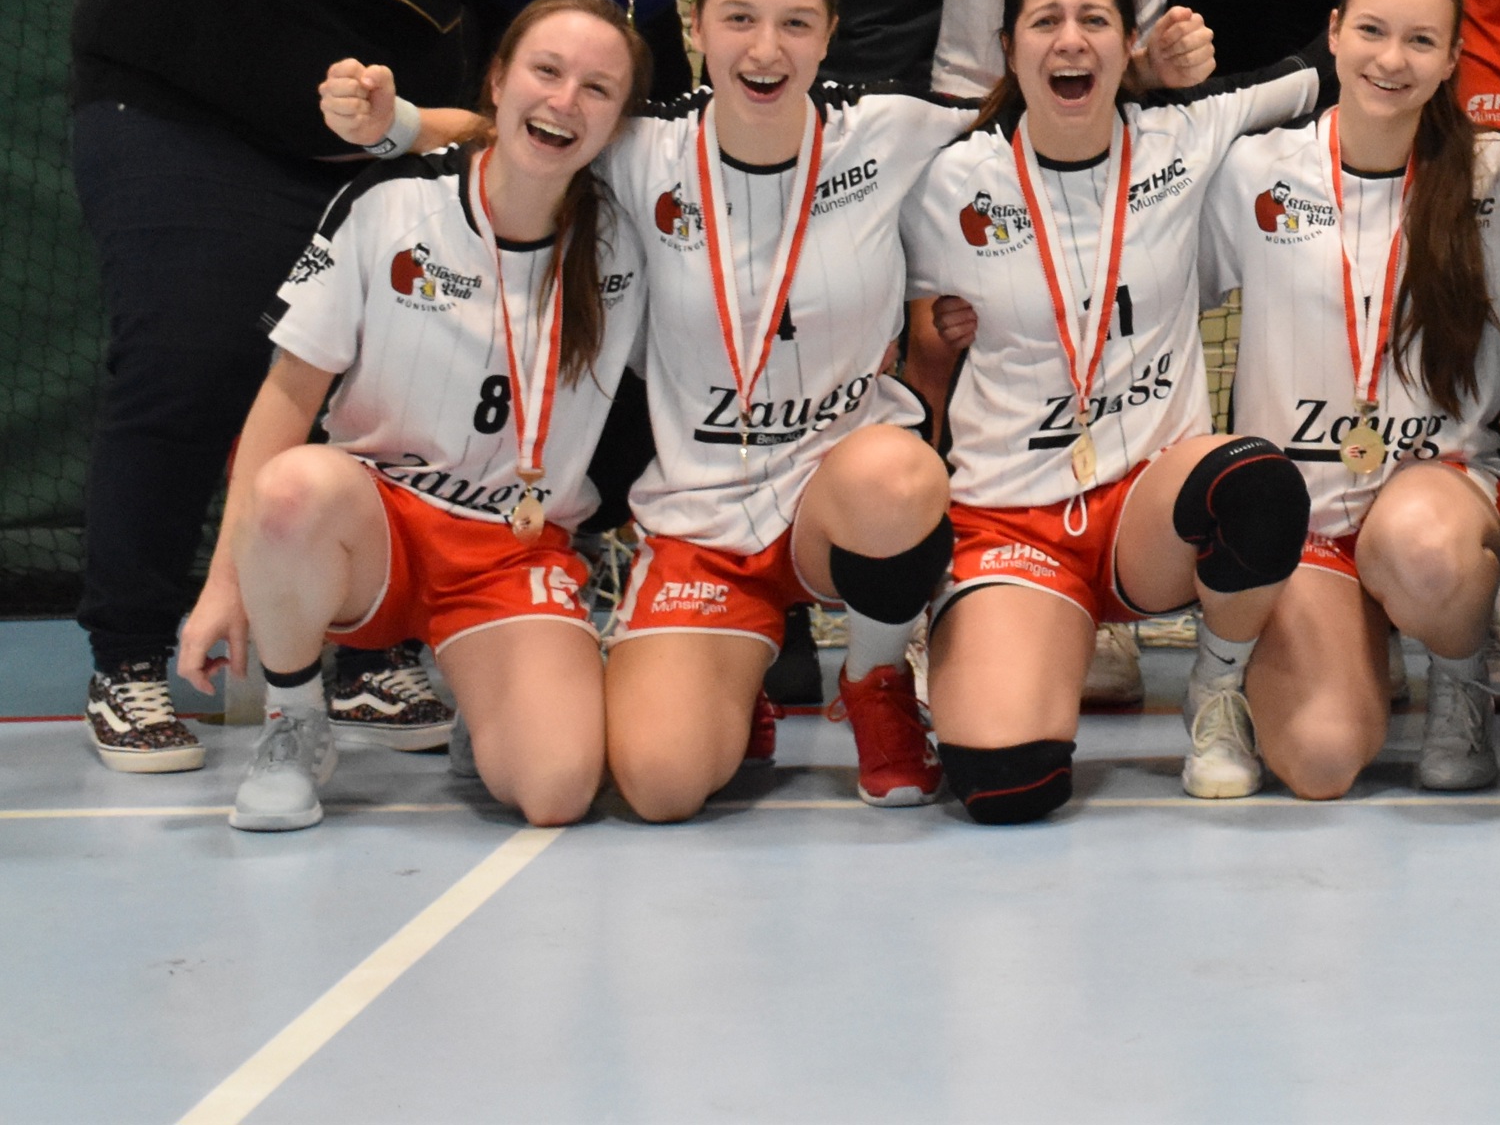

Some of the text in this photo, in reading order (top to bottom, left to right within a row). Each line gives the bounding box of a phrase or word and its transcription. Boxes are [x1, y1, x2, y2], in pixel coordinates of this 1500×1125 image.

[832, 158, 878, 195] HBC
[1306, 214, 1335, 227] Pub
[976, 233, 1034, 257] MÜNSINGEN
[1265, 229, 1323, 244] MÜNSINGEN
[473, 374, 511, 435] 8
[702, 373, 874, 432] Zaugg
[756, 433, 782, 445] Belp
[1290, 399, 1447, 461] Zaugg
[681, 581, 729, 603] HBC
